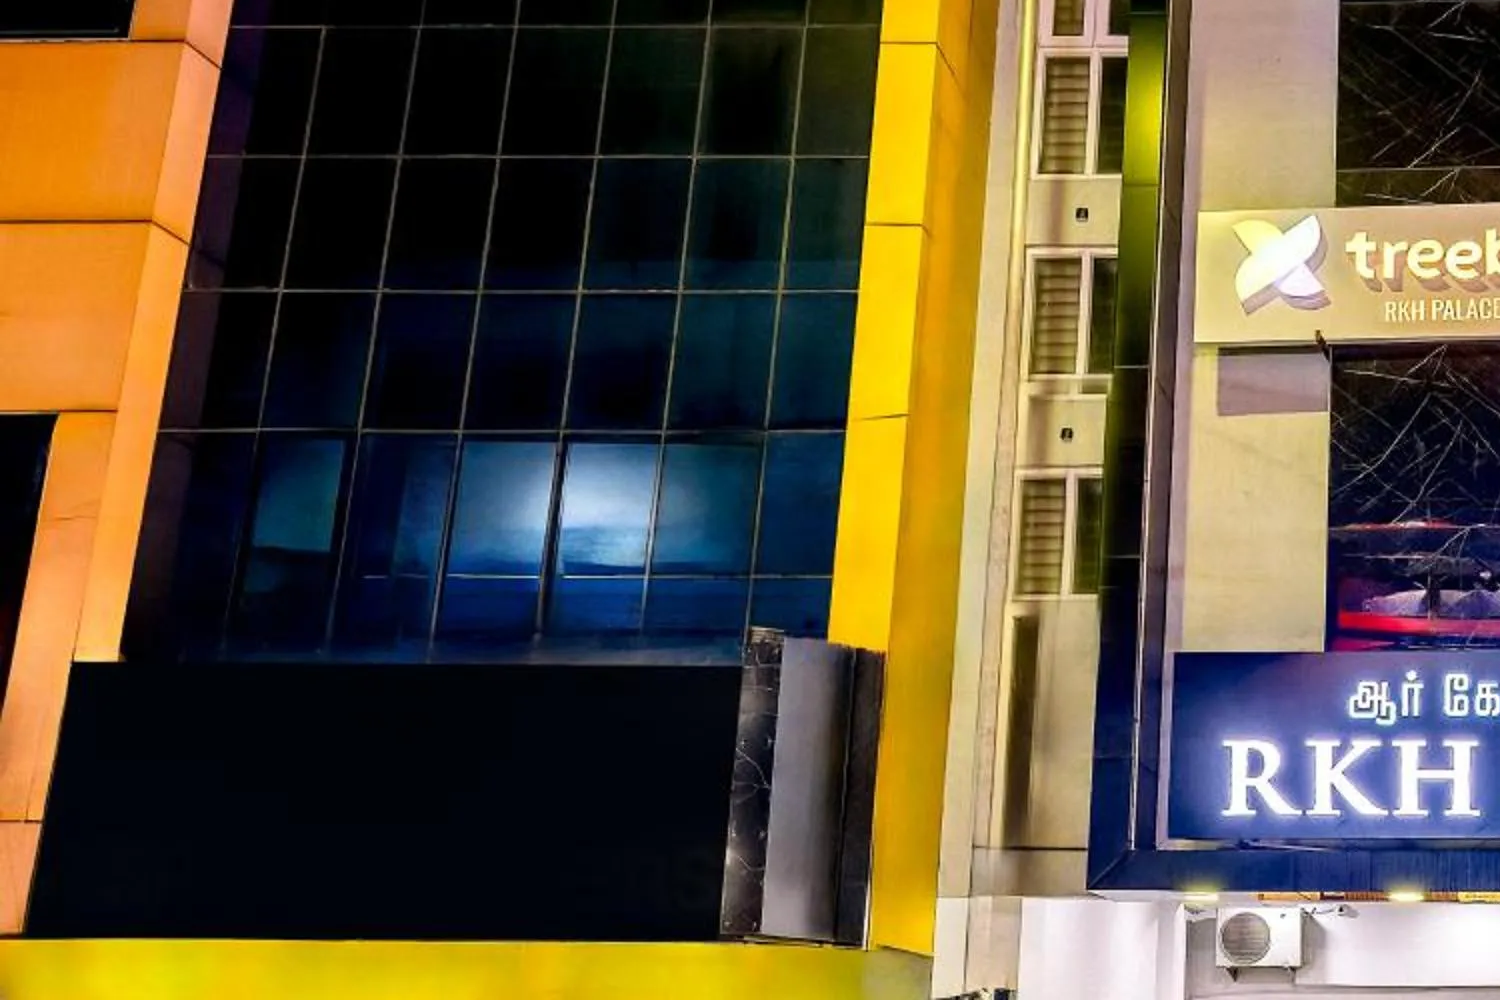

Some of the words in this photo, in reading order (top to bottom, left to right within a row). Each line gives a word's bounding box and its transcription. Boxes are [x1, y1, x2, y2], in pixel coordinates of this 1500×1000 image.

[1385, 299, 1425, 321] RKH
[1348, 668, 1424, 726] ஆர்
[1221, 738, 1482, 818] RKH
